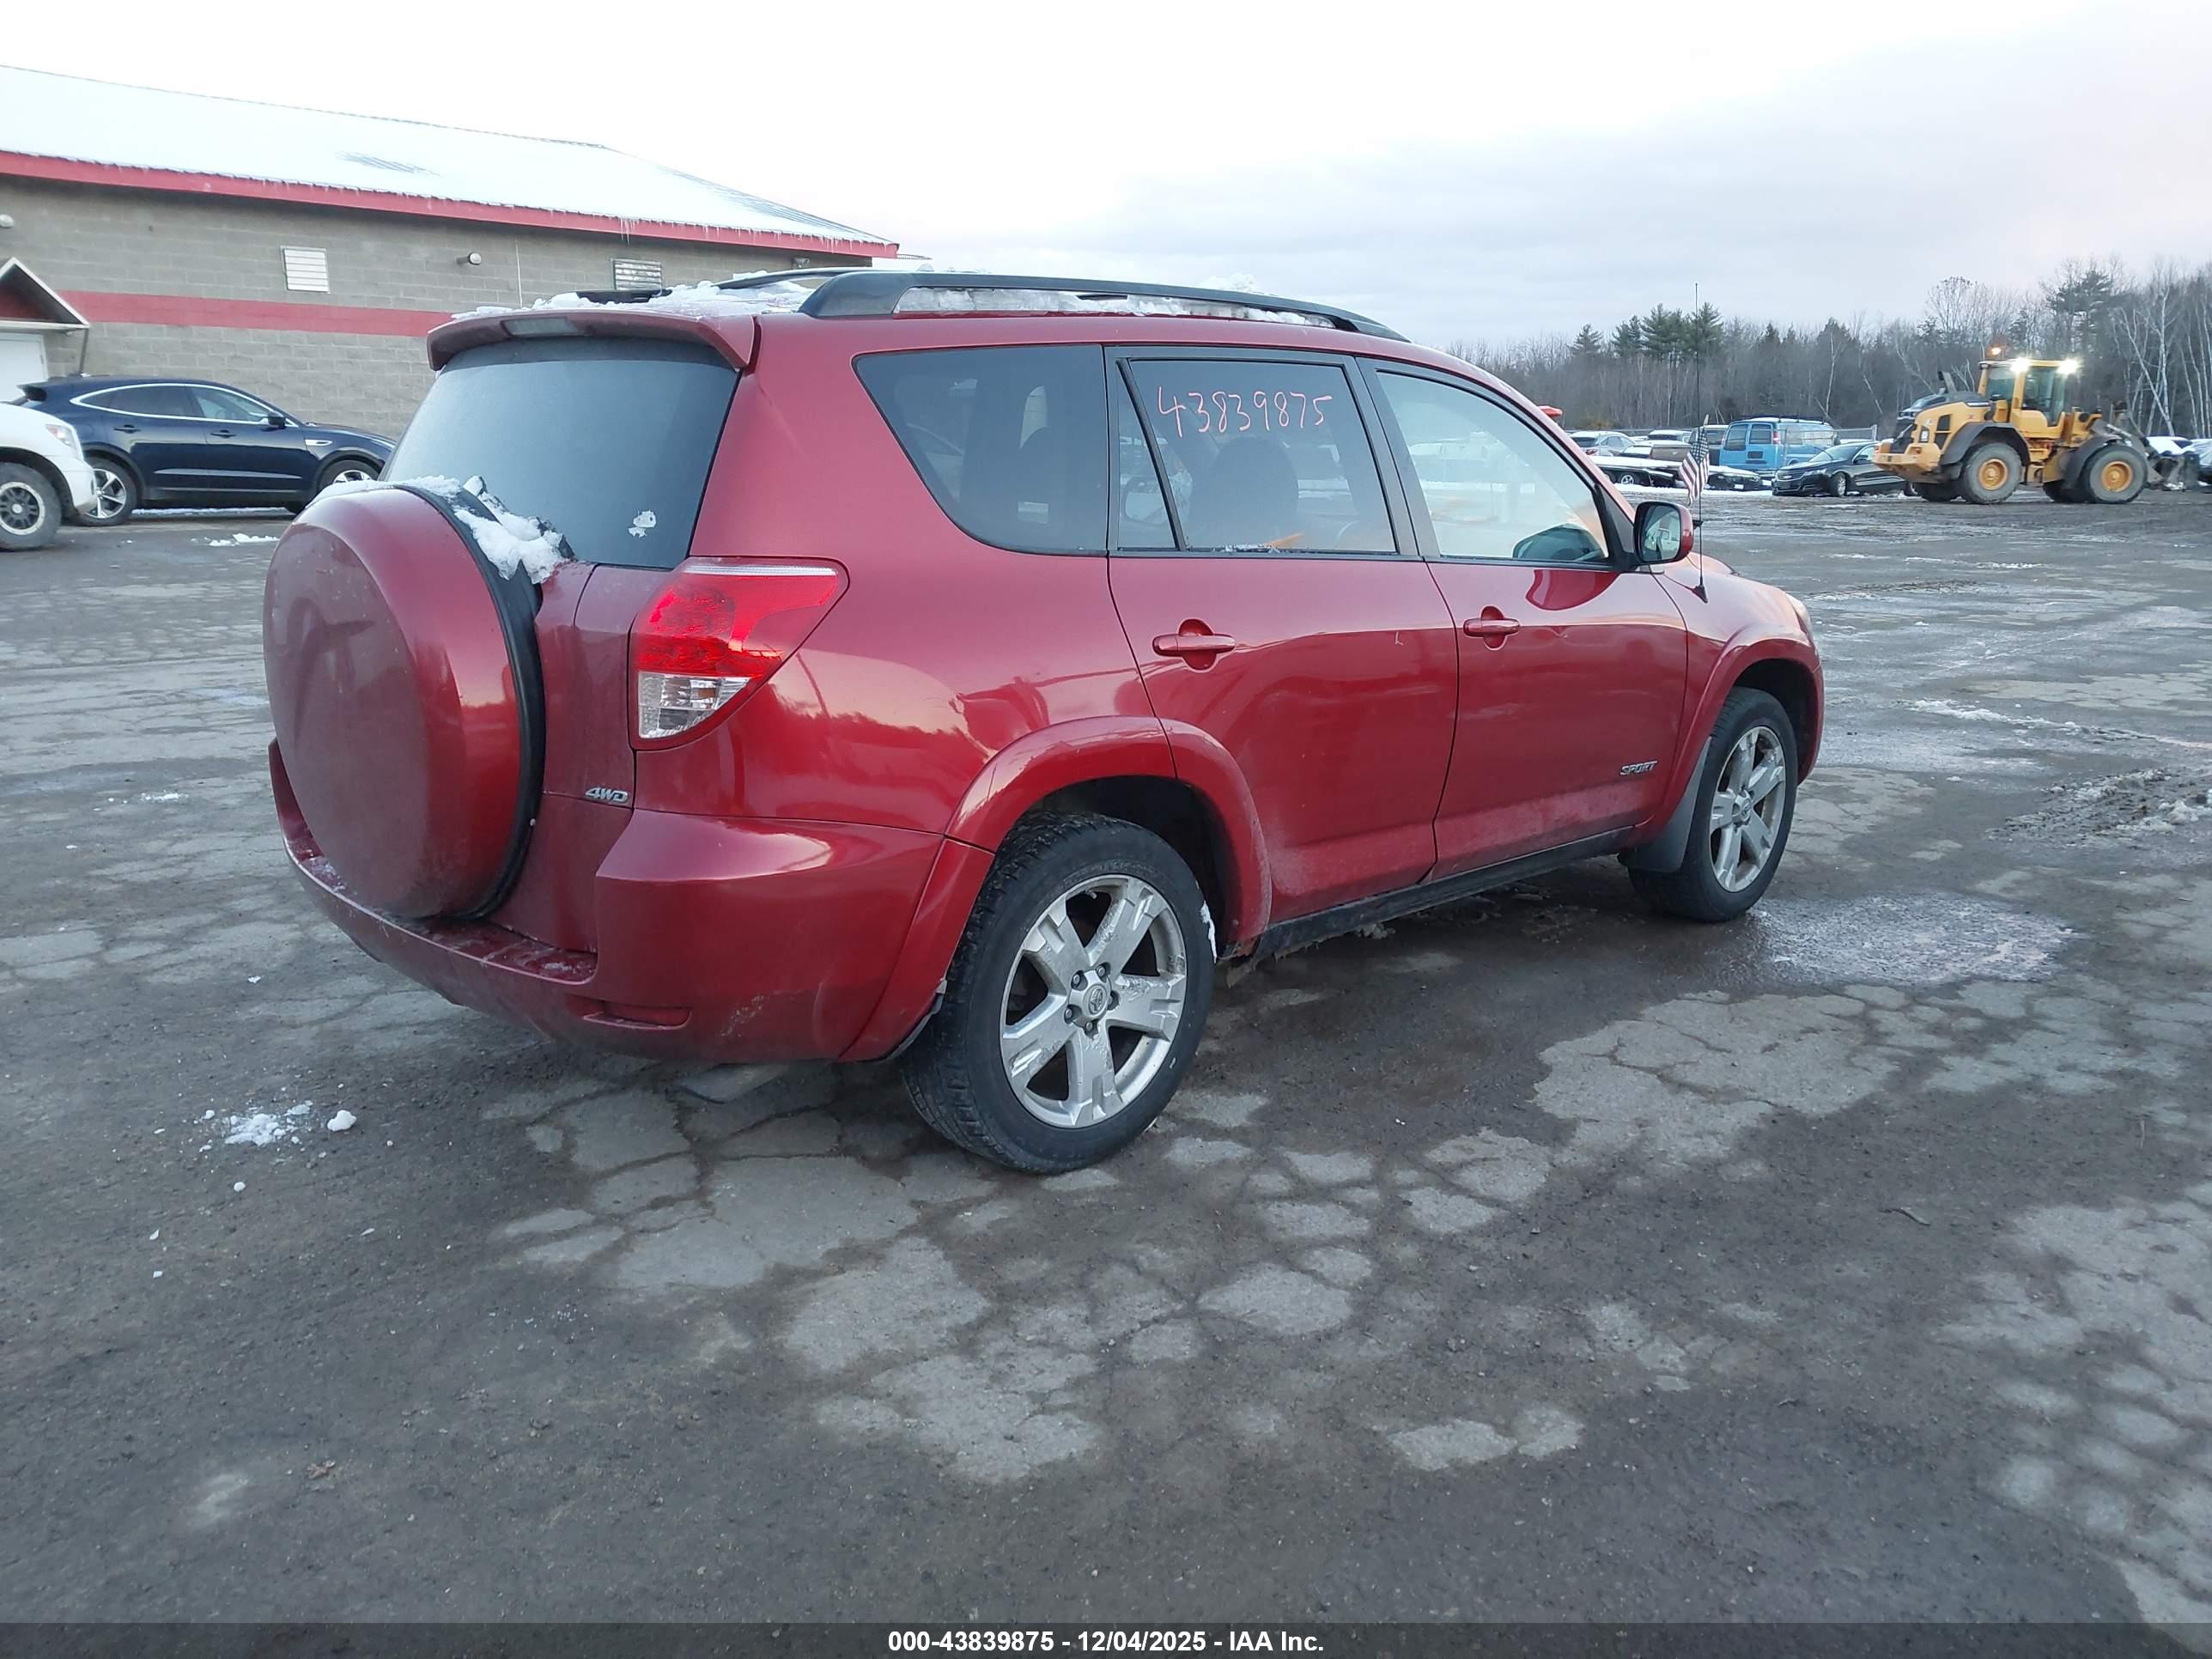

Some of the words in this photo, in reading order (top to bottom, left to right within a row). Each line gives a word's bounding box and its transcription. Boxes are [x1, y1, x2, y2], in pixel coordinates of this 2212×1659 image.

[1157, 386, 1333, 438] 43839875
[1620, 760, 1658, 775] SPORT
[585, 787, 629, 802] 4WD
